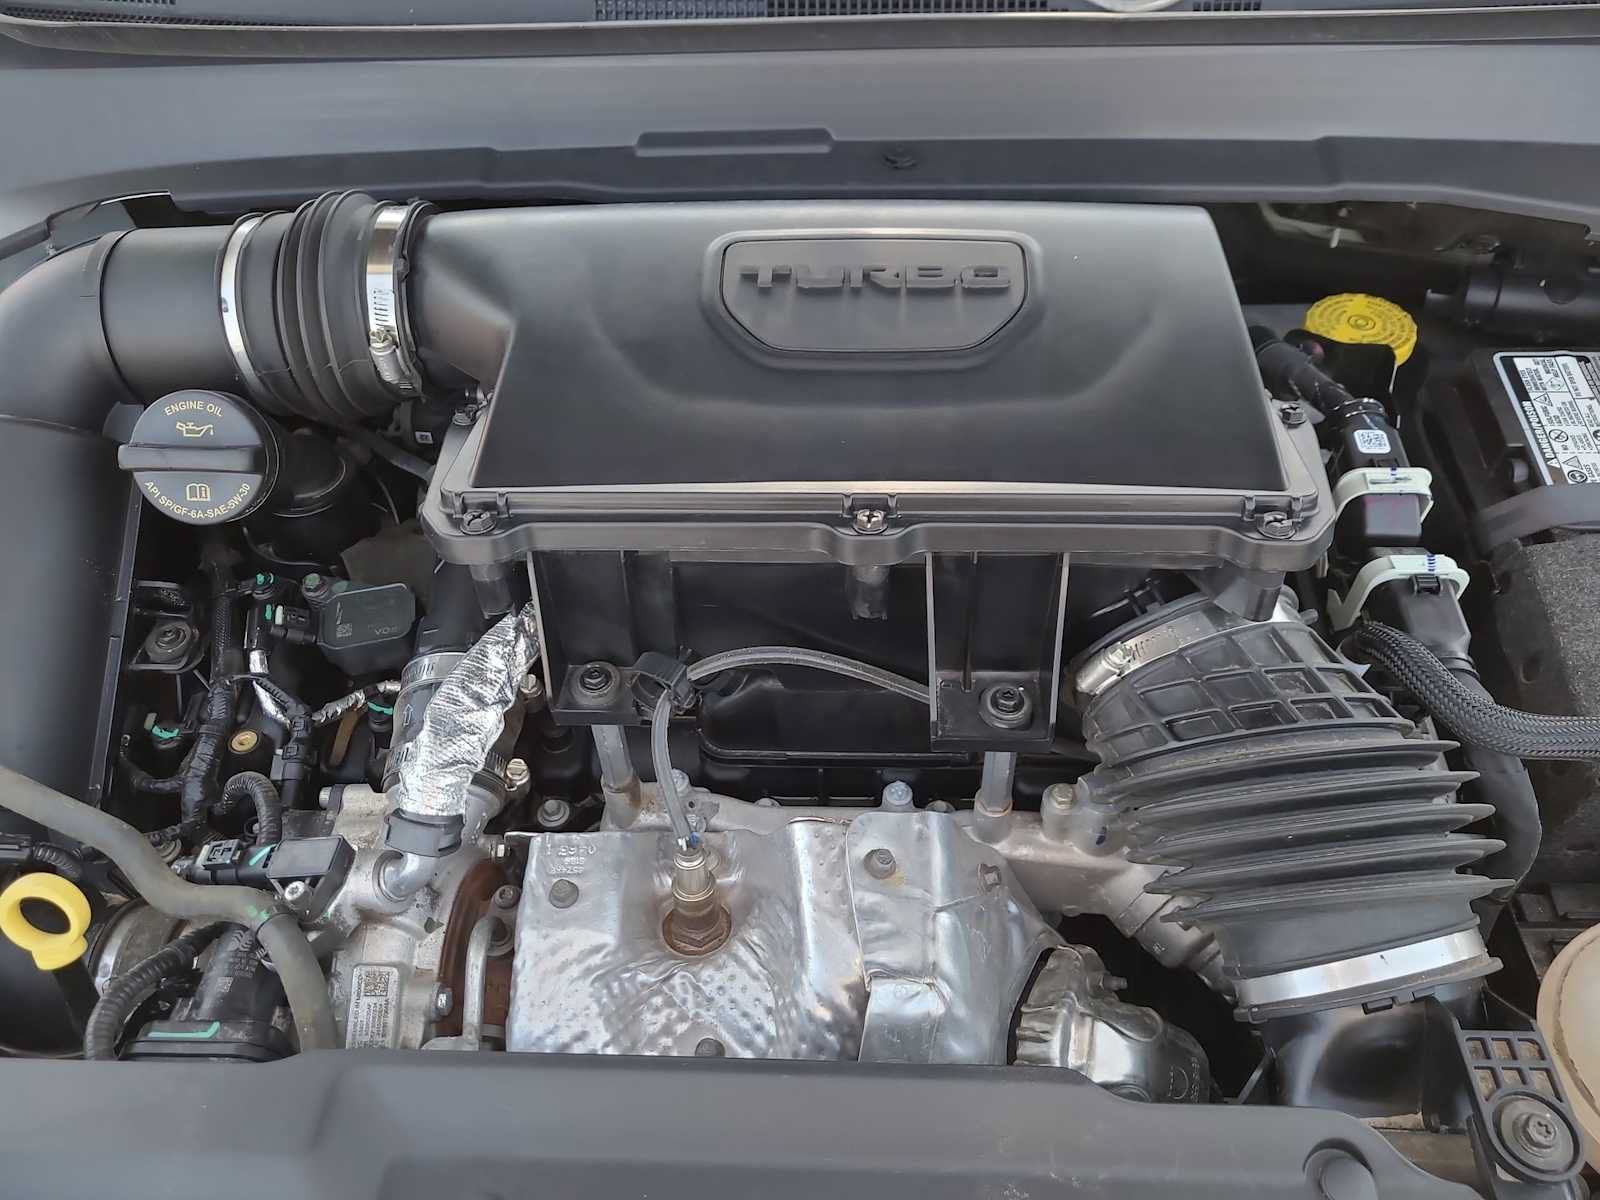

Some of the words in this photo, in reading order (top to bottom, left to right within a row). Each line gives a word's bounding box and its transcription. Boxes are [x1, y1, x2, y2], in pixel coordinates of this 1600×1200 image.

[739, 264, 1012, 290] TURBO
[164, 401, 204, 416] ENGINE
[207, 404, 224, 417] OIL
[1522, 401, 1555, 459] DANGER/POISON
[144, 481, 160, 498] API
